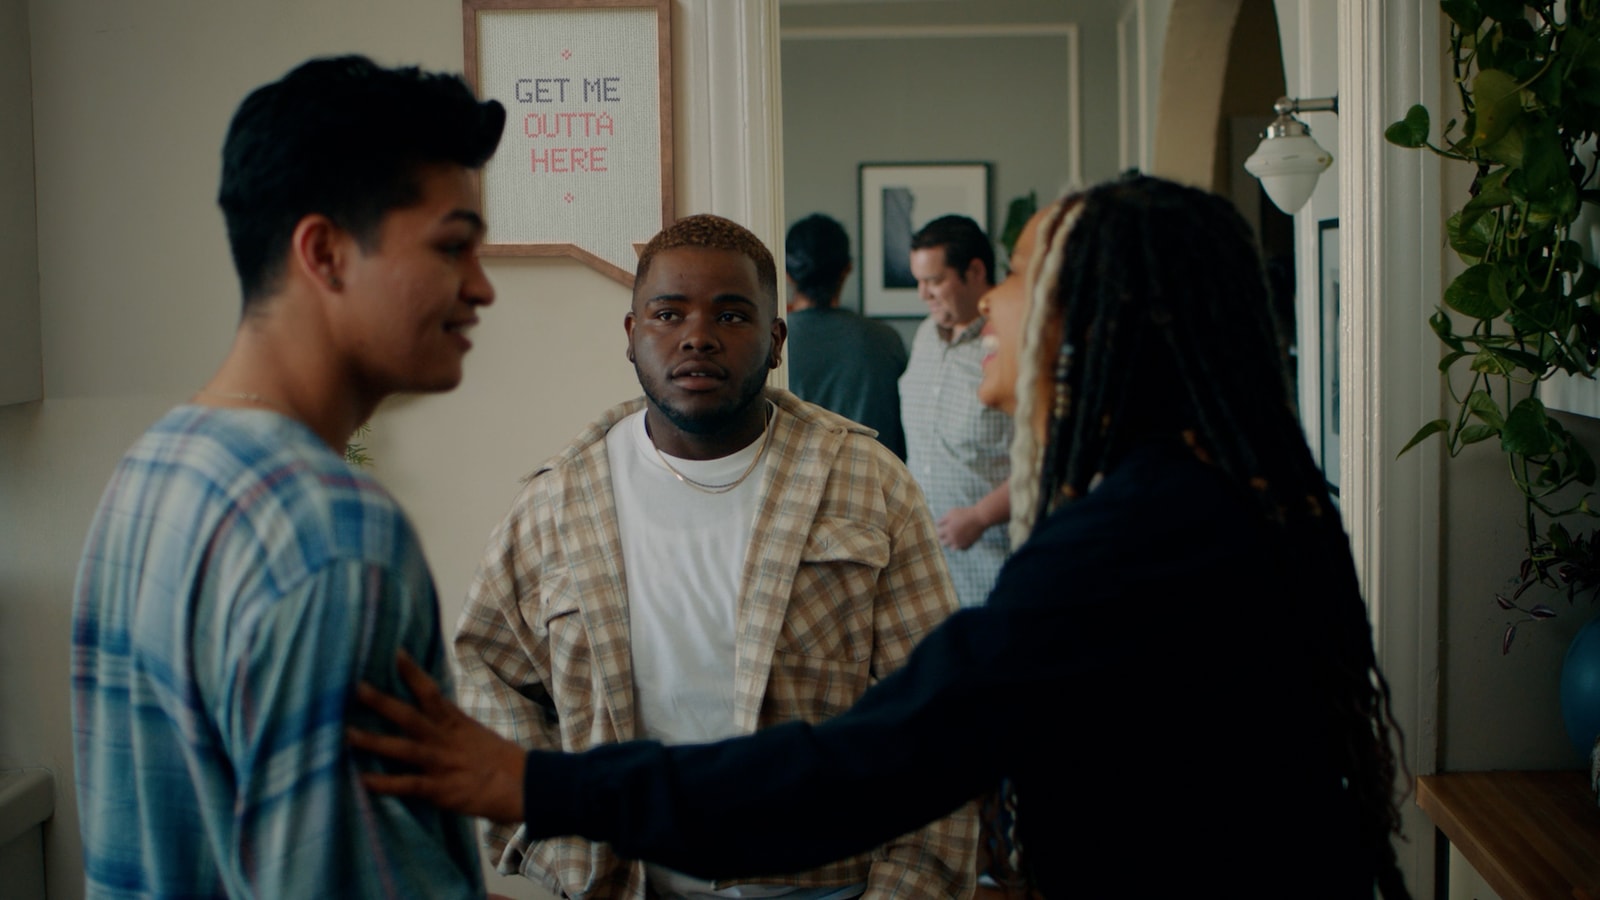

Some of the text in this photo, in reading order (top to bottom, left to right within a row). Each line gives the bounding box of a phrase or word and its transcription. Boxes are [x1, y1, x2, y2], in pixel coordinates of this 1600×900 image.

[515, 77, 621, 103] GET ME
[524, 112, 614, 138] OUTTA
[530, 147, 608, 173] HERE
